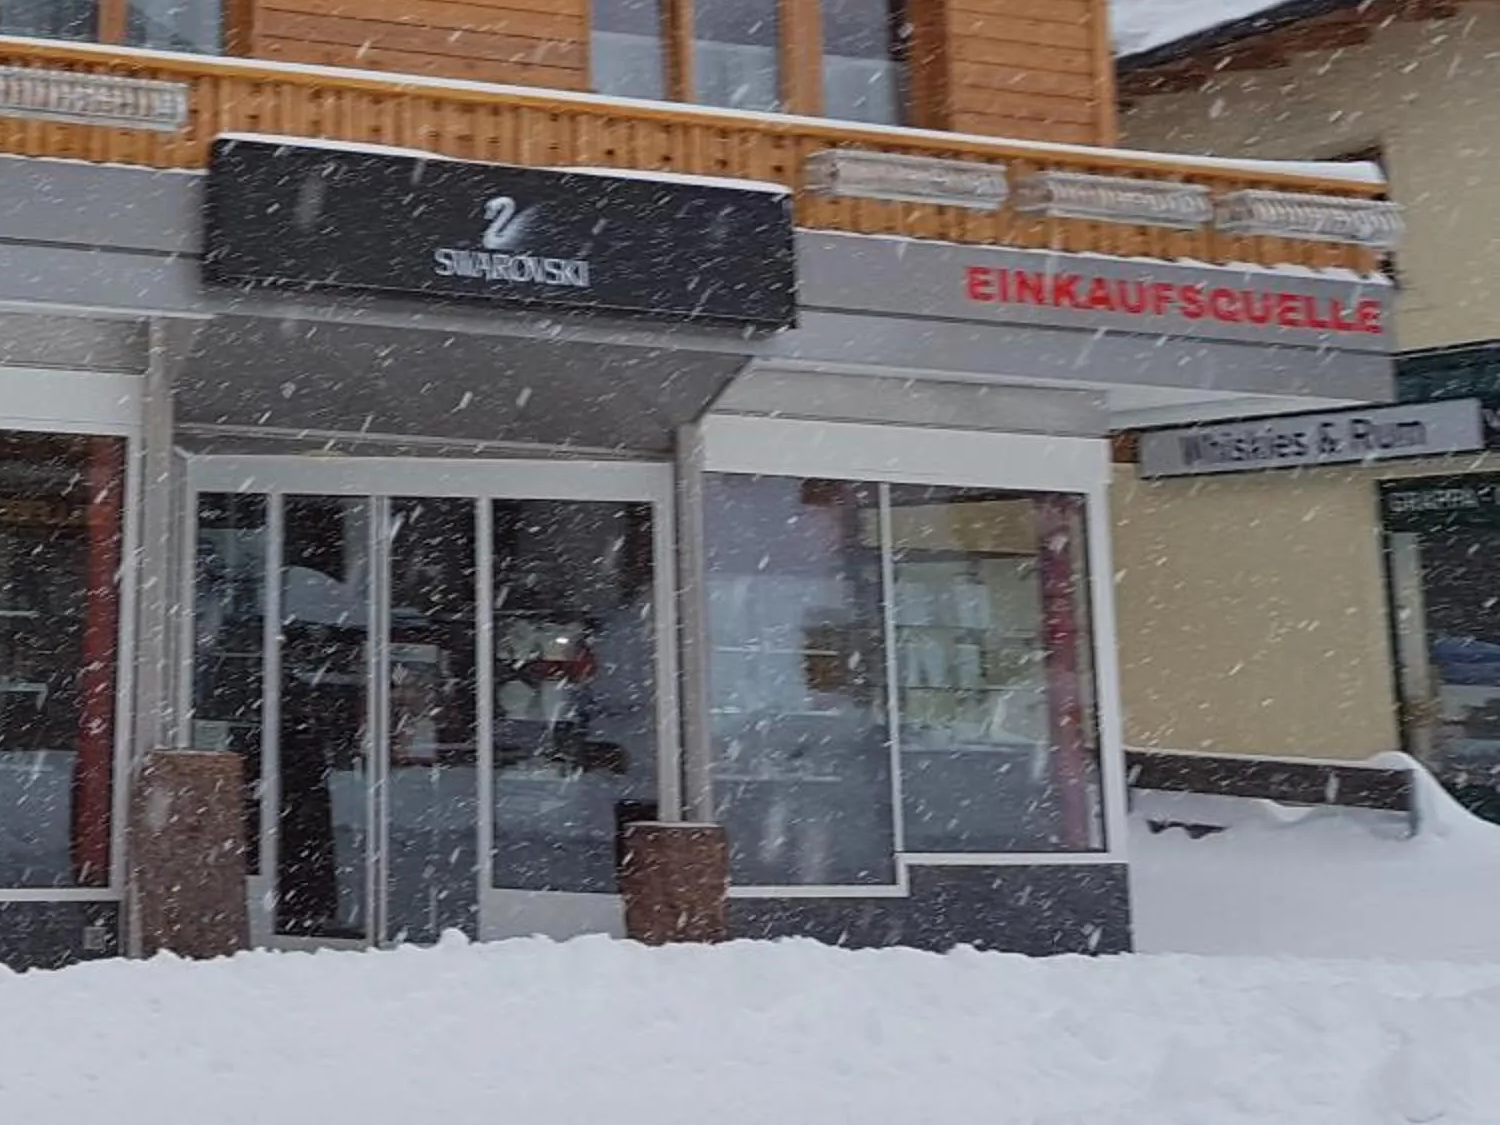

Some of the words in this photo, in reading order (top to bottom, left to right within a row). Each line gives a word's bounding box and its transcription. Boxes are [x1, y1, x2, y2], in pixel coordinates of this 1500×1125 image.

[434, 248, 591, 288] SWAROVSKI
[965, 265, 1384, 335] EINKAUFSQUELLE
[1178, 426, 1309, 466] Whiskies
[1317, 421, 1342, 457] &
[1350, 417, 1428, 452] Rum
